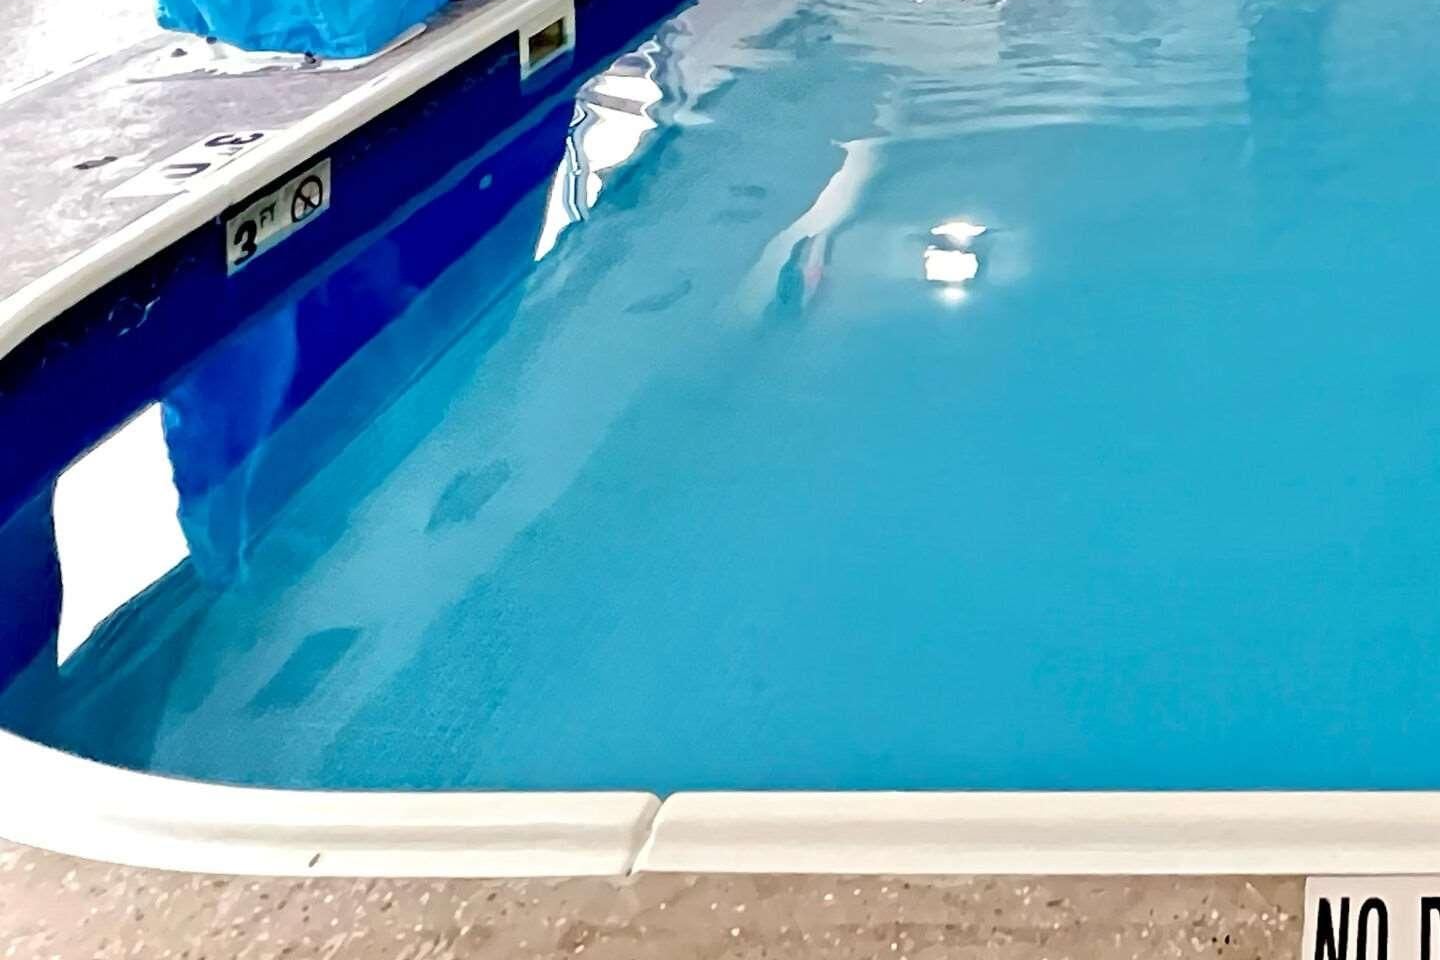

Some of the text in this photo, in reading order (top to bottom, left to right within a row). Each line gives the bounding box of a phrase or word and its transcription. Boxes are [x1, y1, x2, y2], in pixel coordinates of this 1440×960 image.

[233, 200, 278, 266] 3 FT
[1313, 896, 1389, 960] NO
